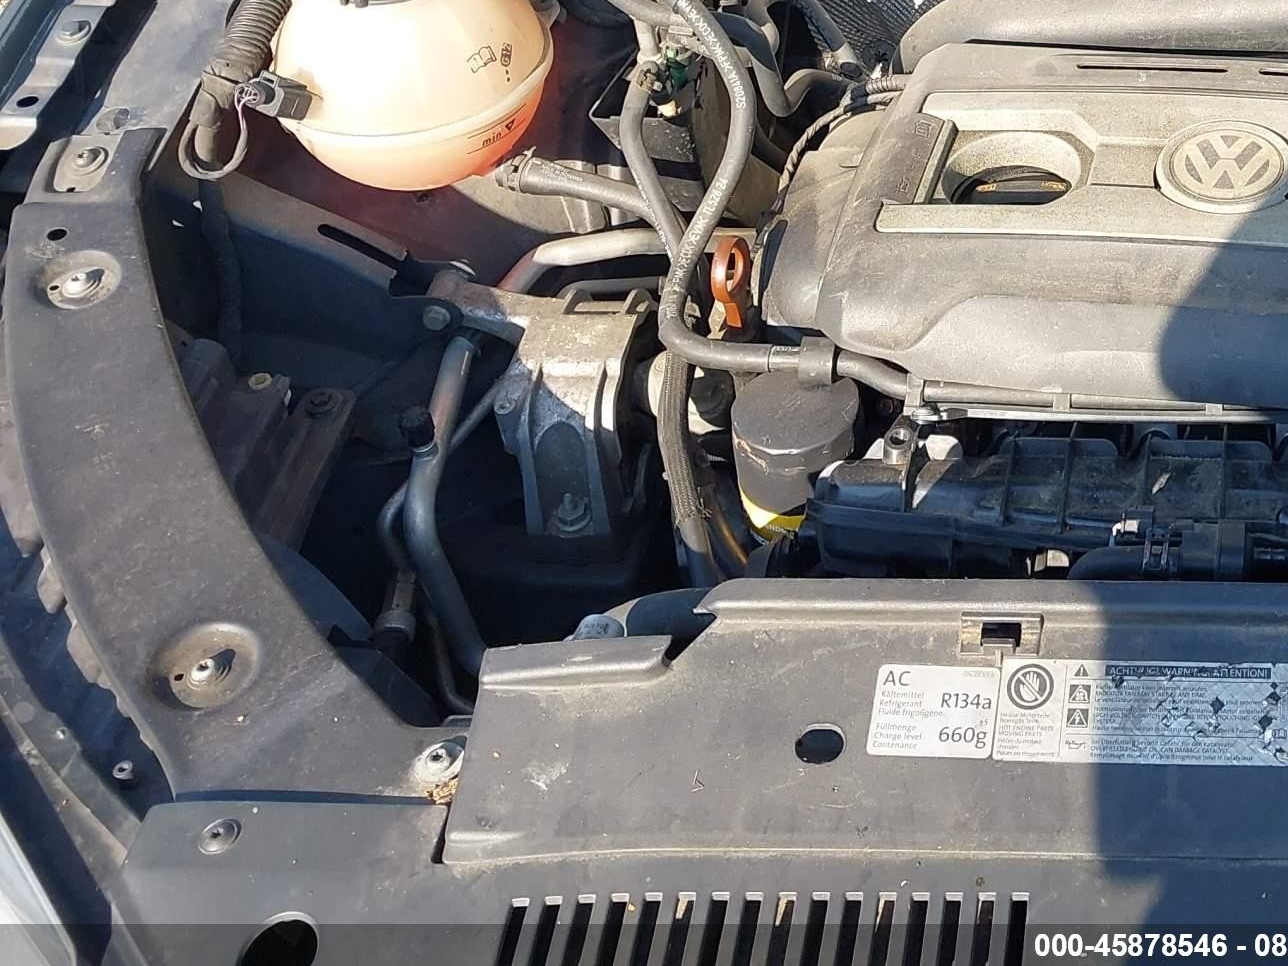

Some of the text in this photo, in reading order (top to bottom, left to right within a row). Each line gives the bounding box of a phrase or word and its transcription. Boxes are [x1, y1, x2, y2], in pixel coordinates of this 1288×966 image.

[482, 131, 502, 147] min
[1177, 132, 1279, 197] VW
[883, 670, 911, 686] AC
[1110, 666, 1160, 675] ACHTG!
[880, 699, 923, 709] Refrigerant
[940, 692, 992, 710] R134a
[873, 731, 923, 741] Charge level
[938, 726, 988, 749] 660g
[872, 740, 918, 749] Contenance
